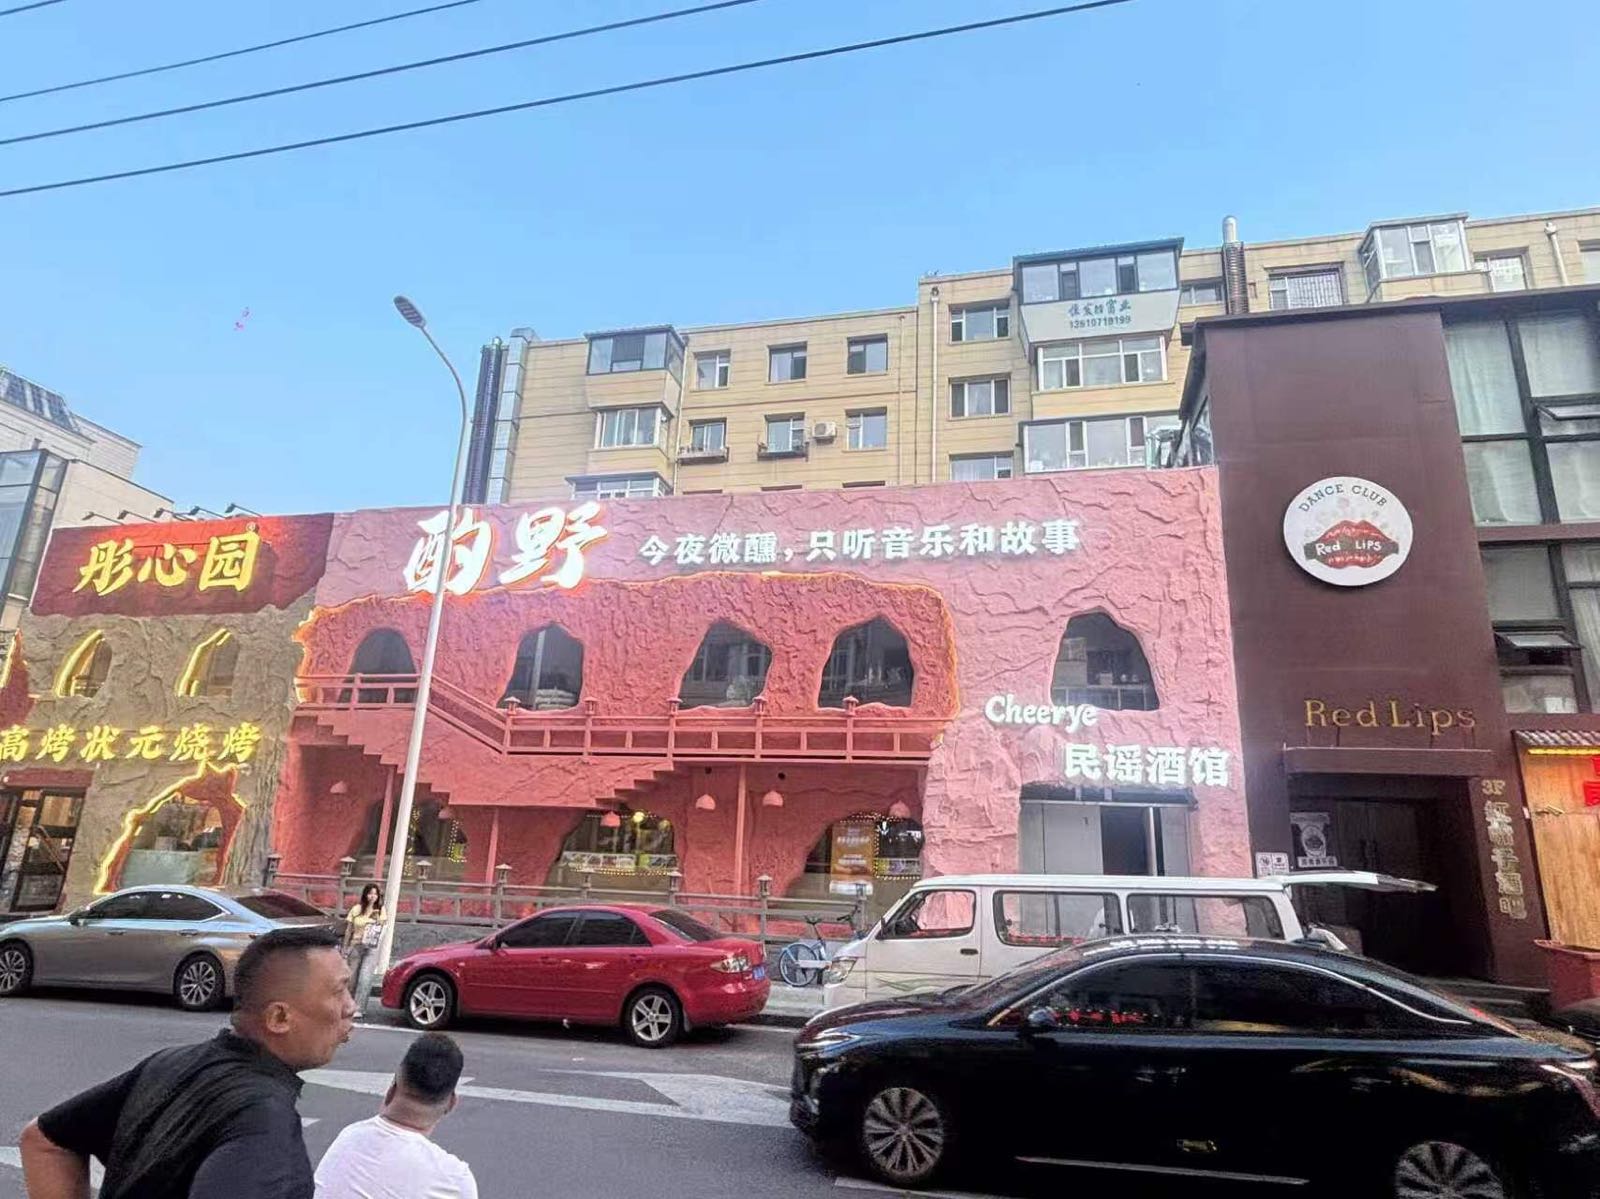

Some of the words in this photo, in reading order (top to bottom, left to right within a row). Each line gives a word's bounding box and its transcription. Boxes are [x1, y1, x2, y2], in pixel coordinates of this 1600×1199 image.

[1299, 483, 1344, 512] DANCE
[1351, 485, 1388, 507] CLUB
[72, 531, 261, 596] 彤心园
[1315, 540, 1341, 556] Red
[985, 693, 1098, 734] Cheerye
[1304, 699, 1380, 728] Red
[1388, 698, 1476, 737] Lips
[0, 722, 261, 763] 高烤状元烧烤
[1065, 743, 1231, 788] 民谣酒馆
[1482, 779, 1505, 795] 3F
